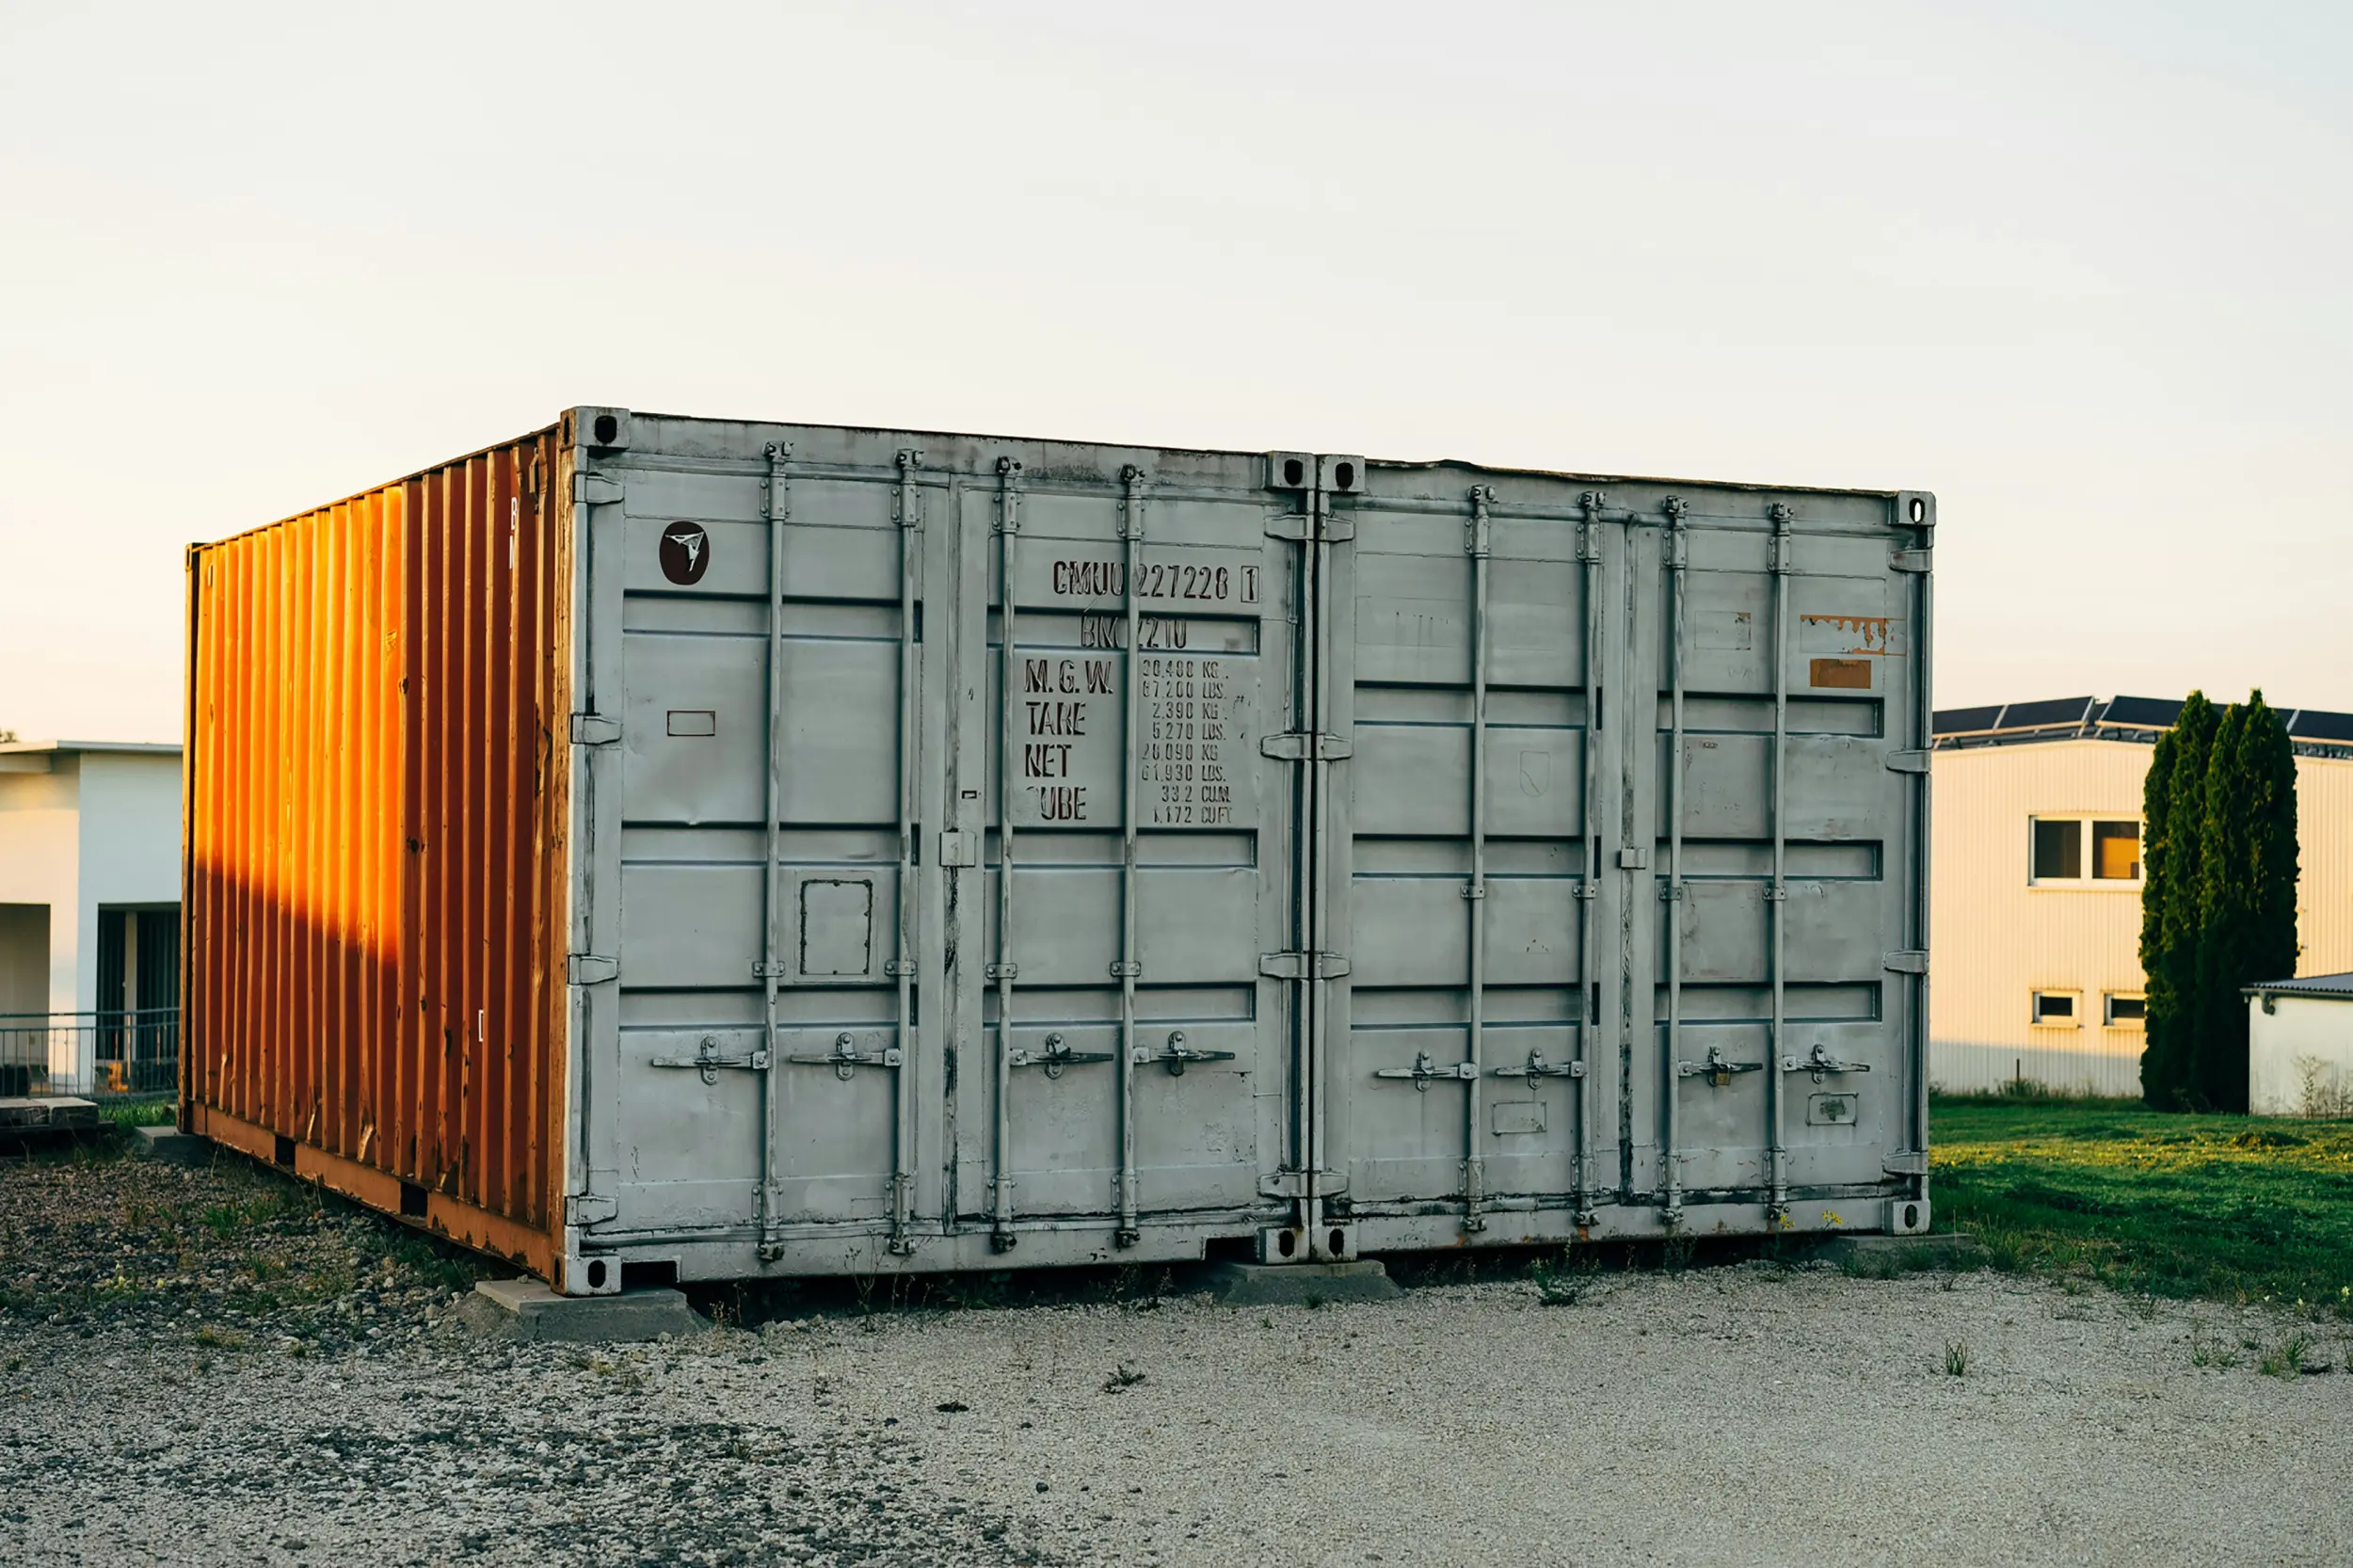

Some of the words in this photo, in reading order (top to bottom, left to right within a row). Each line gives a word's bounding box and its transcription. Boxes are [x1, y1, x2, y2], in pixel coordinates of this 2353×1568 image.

[1137, 564, 1228, 600] 227228
[1025, 701, 1086, 736] TARE
[1152, 701, 1193, 720] 2.390
[1152, 721, 1193, 740] 5.270
[1025, 744, 1072, 777] NET
[1026, 786, 1086, 821] UBE
